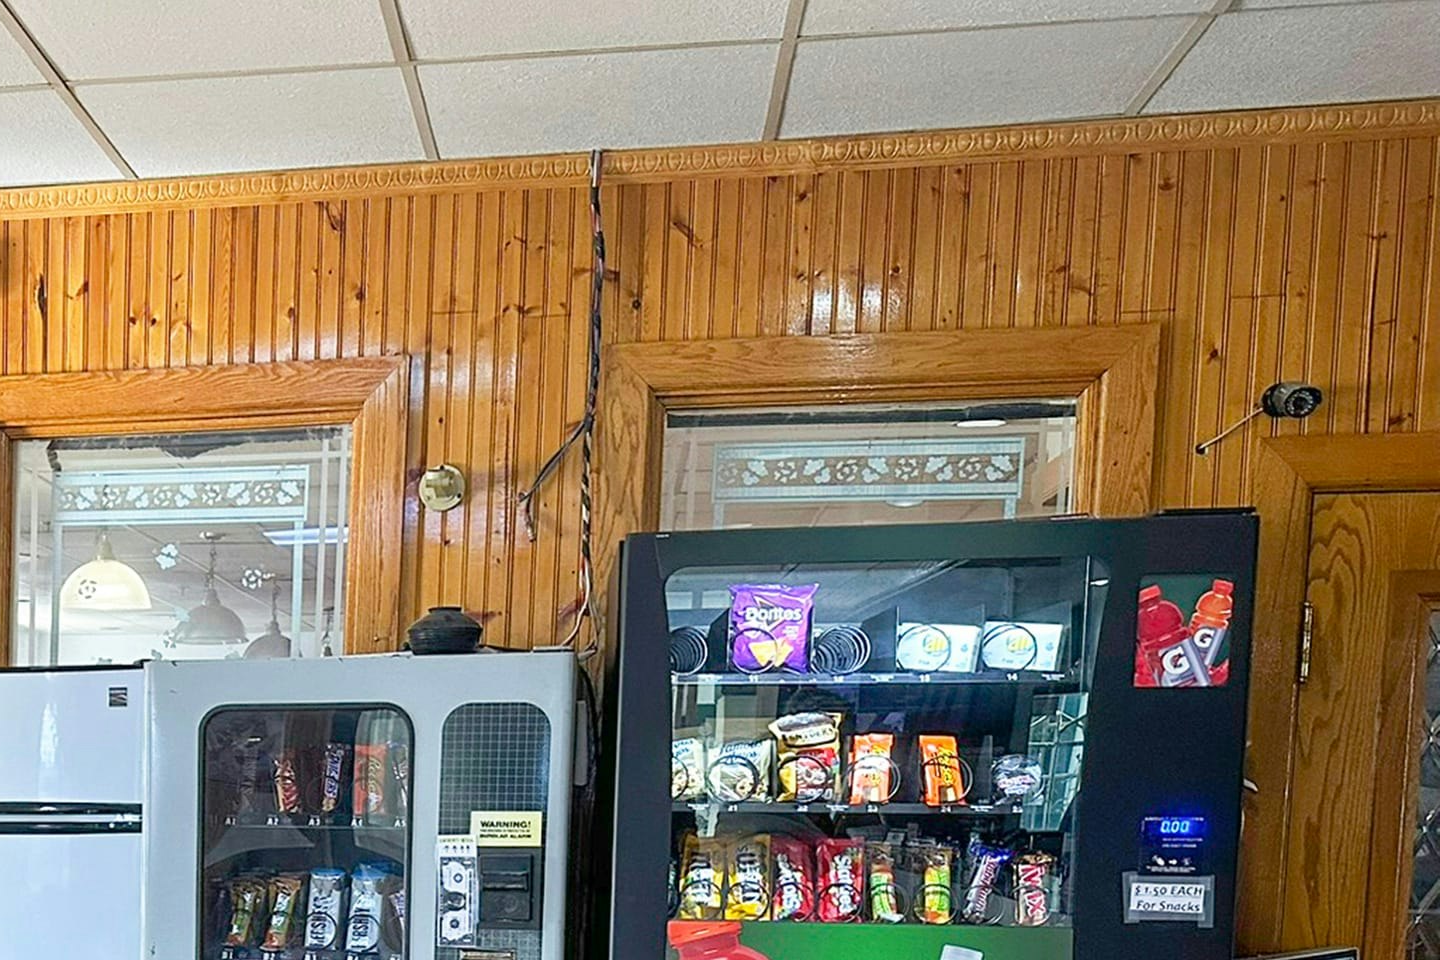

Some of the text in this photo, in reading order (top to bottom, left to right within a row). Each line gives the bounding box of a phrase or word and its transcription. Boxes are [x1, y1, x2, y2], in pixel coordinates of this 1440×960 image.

[1194, 628, 1215, 648] G
[1161, 646, 1190, 675] G
[480, 821, 531, 829] WARNING!
[1170, 886, 1203, 896] EACH
[1136, 900, 1200, 912] For Snacks
